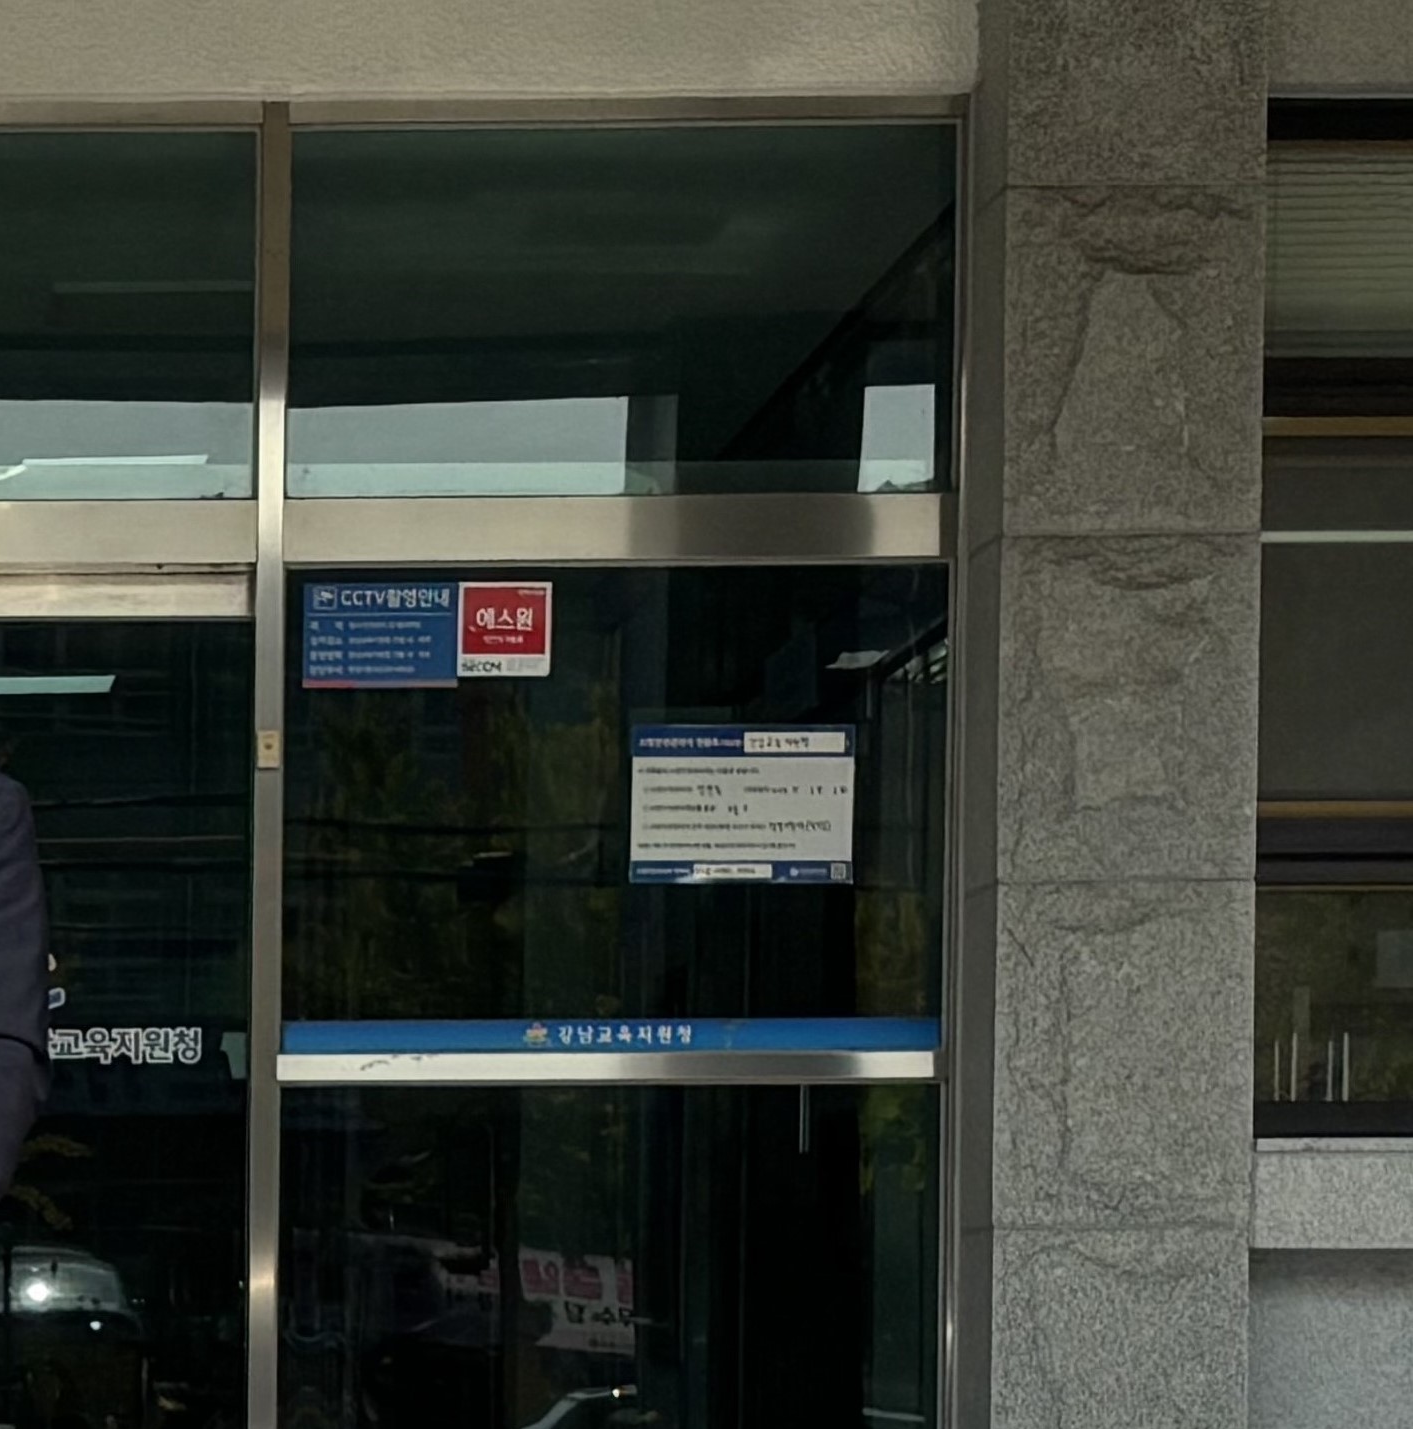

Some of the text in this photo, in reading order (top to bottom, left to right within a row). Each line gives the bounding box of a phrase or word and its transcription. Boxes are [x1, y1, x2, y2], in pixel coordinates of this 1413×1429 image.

[476, 607, 533, 631] 에스원
[48, 1027, 202, 1064] 교육지원청
[558, 1024, 692, 1045] 강남교육지원청
